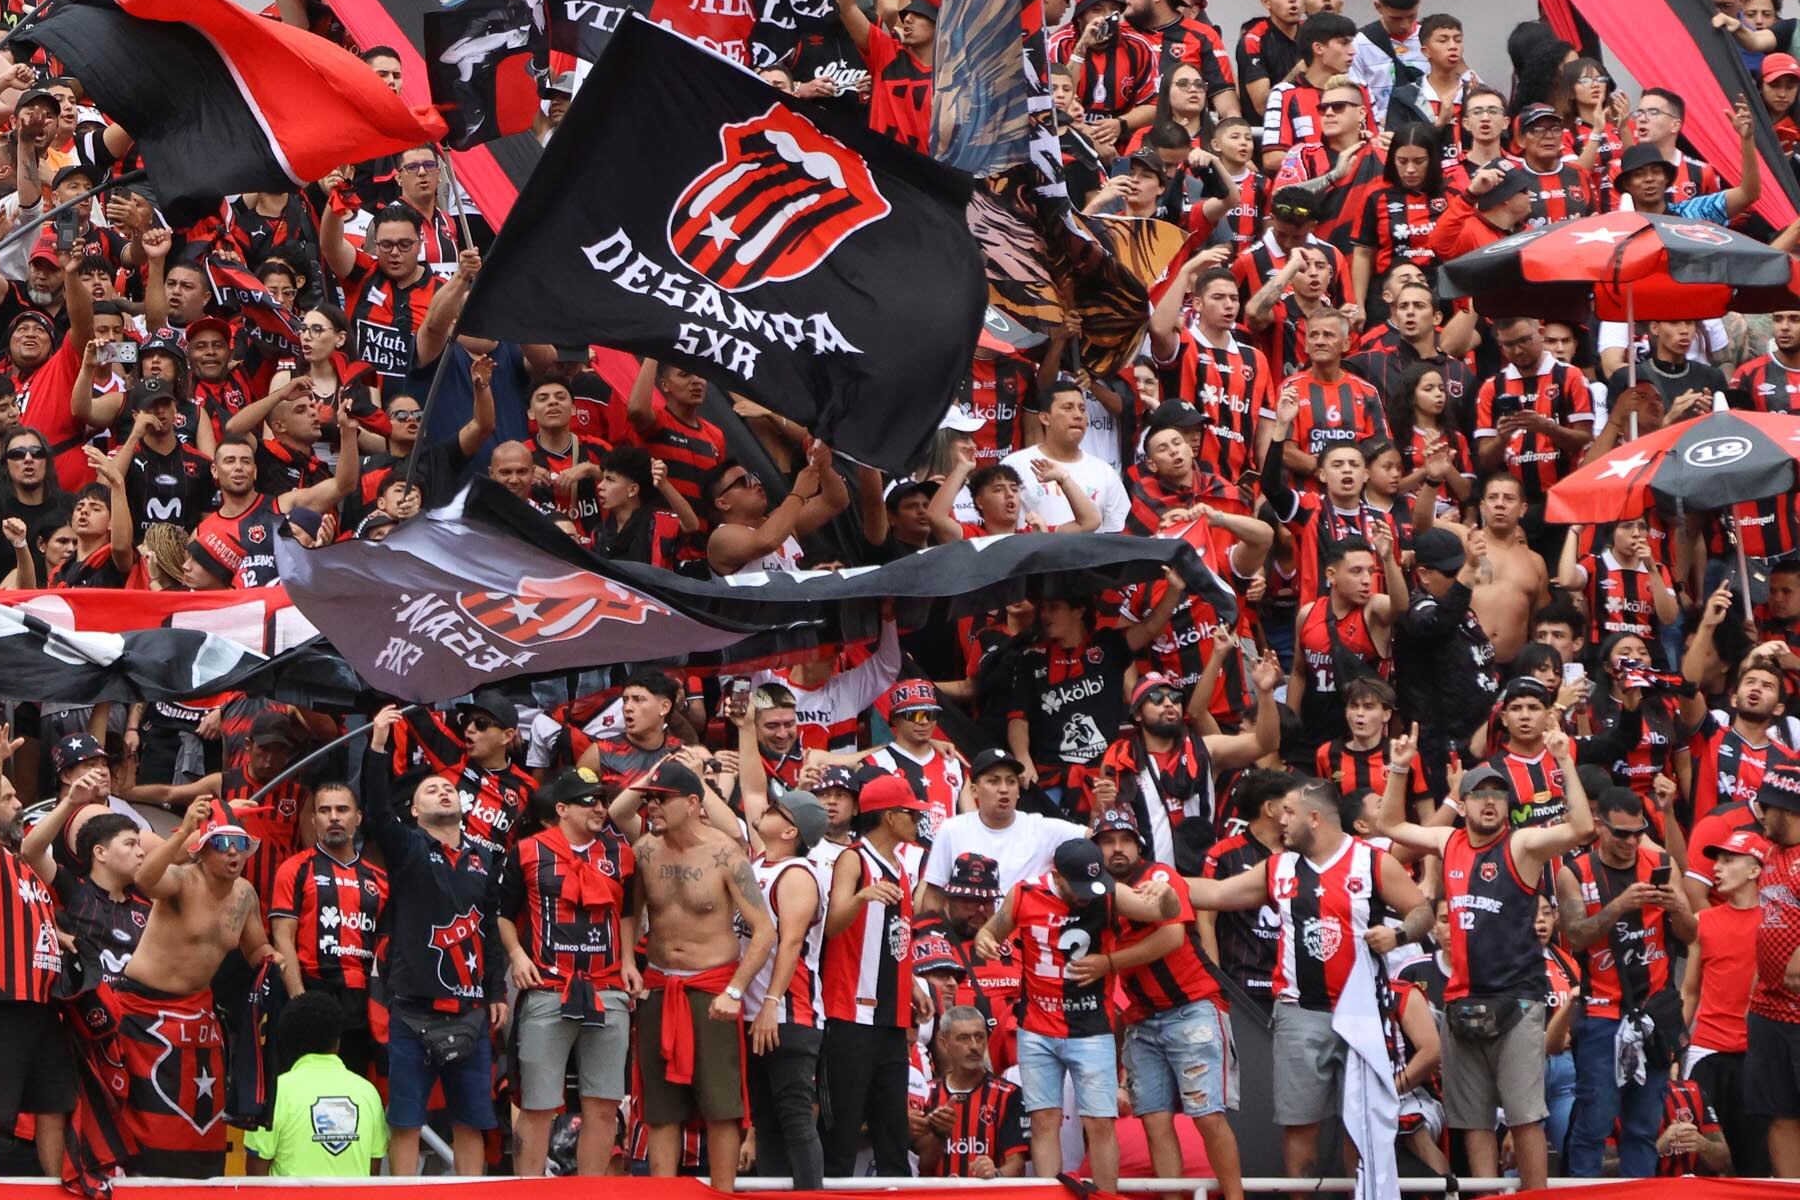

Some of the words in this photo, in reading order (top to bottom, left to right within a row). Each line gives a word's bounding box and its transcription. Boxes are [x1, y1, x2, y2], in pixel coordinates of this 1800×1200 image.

[673, 322, 762, 380] SXR
[975, 403, 1017, 419] kölbi
[1218, 393, 1250, 414] klbi
[1327, 405, 1340, 420] 6
[1312, 431, 1354, 440] Grupo
[1696, 444, 1743, 460] 12
[763, 561, 783, 570] L.D.A
[242, 571, 256, 586] 12
[1060, 676, 1105, 699] kölbi
[473, 805, 512, 832] kölbi
[342, 911, 376, 932] kölbi
[1459, 912, 1476, 930] 12
[554, 943, 578, 951] Banco
[1031, 926, 1092, 979] 12
[947, 1137, 988, 1154] kölbi
